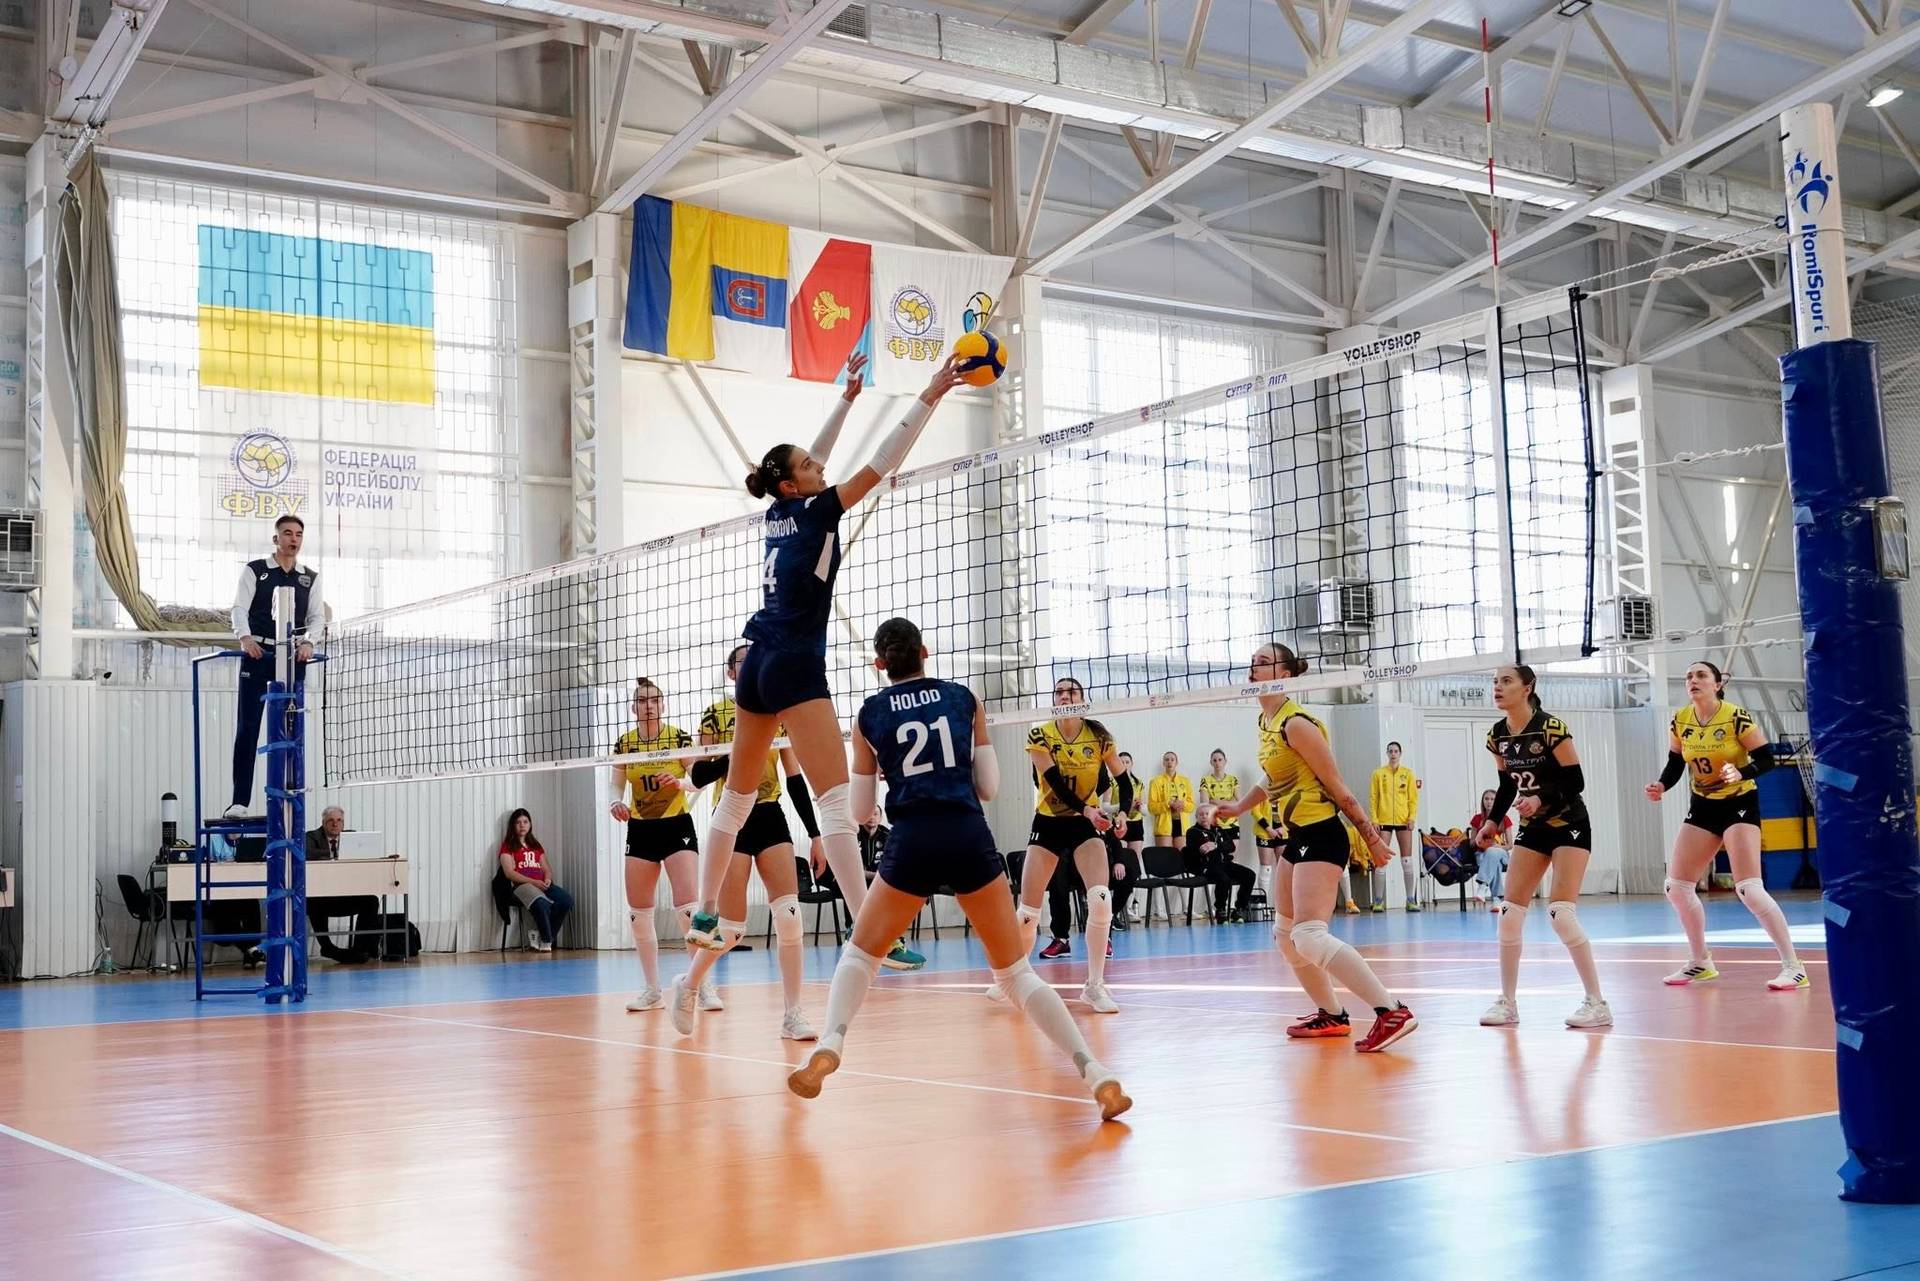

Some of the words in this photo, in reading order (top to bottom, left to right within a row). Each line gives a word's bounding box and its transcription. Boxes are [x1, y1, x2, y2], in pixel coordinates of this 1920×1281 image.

[888, 336, 944, 361] ФВУ
[1344, 331, 1421, 362] VOLLEYSHOP
[1225, 383, 1253, 398] СУПЕР
[1038, 421, 1095, 446] VOLLEYSHOP
[325, 449, 416, 472] ФЕДЕРАЦІЯ
[325, 469, 421, 491] ВОЛЕЙБОЛУ
[325, 490, 393, 511] УКРАЇНИ
[762, 547, 779, 593] 4
[1362, 664, 1418, 679] VOLLEYSHOP
[889, 688, 941, 712] HOLOD
[896, 715, 956, 778] 21
[1692, 757, 1713, 775] 13
[640, 774, 660, 792] 10
[1511, 771, 1541, 791] 22
